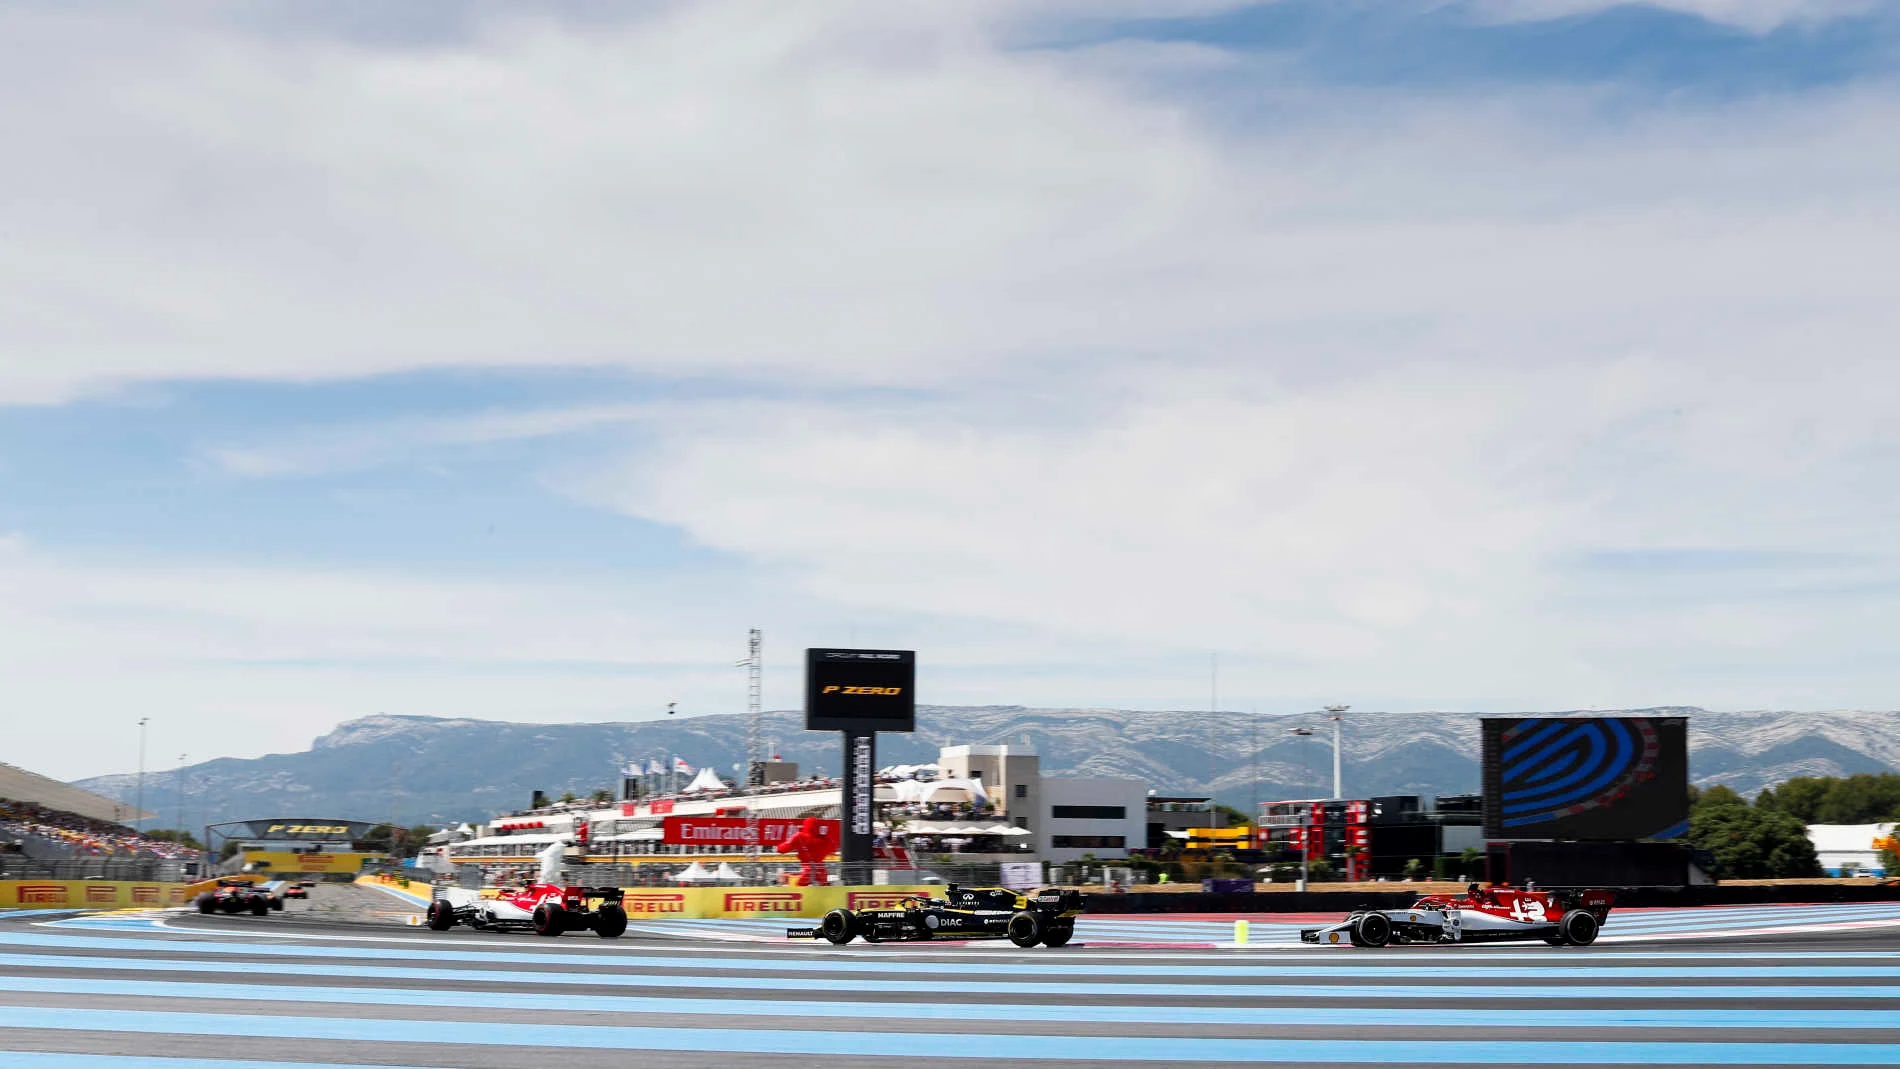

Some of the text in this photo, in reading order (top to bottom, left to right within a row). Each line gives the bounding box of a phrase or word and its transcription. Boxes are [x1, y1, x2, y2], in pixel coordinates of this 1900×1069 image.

[821, 685, 903, 695] P ZERO
[267, 824, 349, 834] P ZERO
[680, 823, 758, 840] Emirates
[724, 893, 803, 912] PIRELLI
[1013, 895, 1028, 910] 3
[940, 918, 962, 927] DIAC
